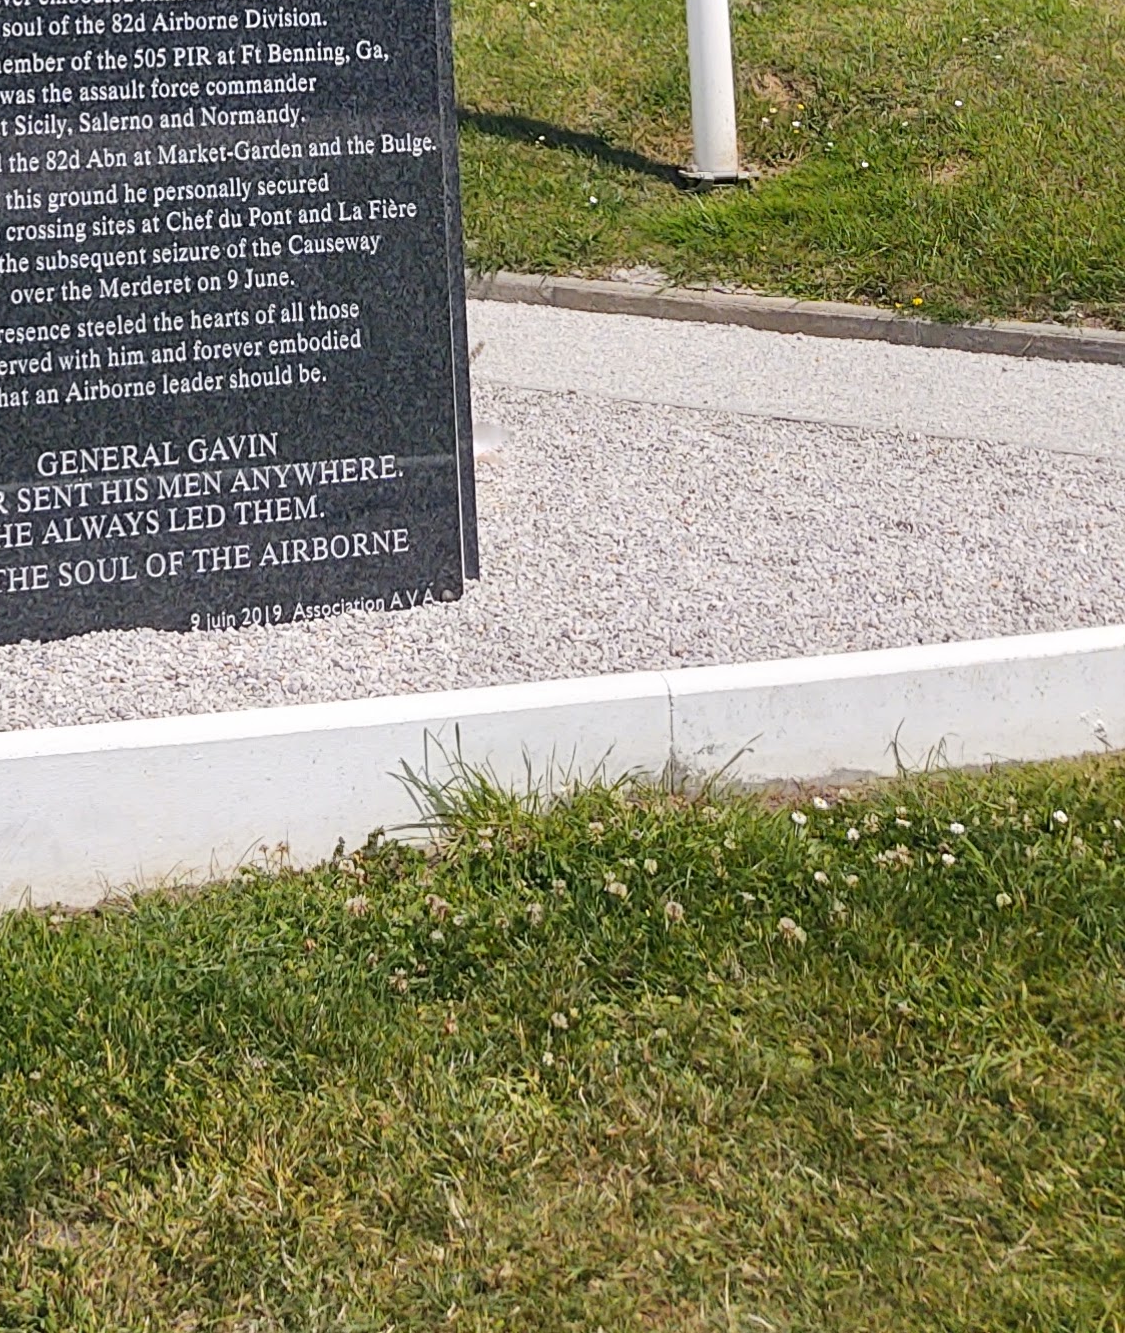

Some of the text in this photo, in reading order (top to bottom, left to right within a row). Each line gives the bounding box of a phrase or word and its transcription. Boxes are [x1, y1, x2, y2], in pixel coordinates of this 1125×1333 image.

[2, 16, 43, 38] soul
[48, 14, 71, 36] of
[74, 14, 106, 35] the
[111, 12, 147, 34] 82d
[151, 11, 239, 33] Airborne
[244, 6, 328, 29] Division.
[70, 50, 93, 72] of
[96, 48, 128, 71] the
[133, 47, 167, 69] 505
[172, 46, 212, 68] PIR
[216, 46, 236, 66] at
[240, 44, 262, 65] Ft
[267, 40, 351, 67] Benning,
[355, 38, 390, 63] Ga,
[41, 82, 73, 104] the
[79, 78, 146, 102] assault
[150, 76, 200, 99] force
[205, 72, 317, 97] commander
[14, 113, 73, 140] Sicily,
[79, 111, 154, 133] Salerno
[159, 107, 195, 129] and
[200, 102, 307, 129] Normandy.
[8, 151, 40, 173] the
[45, 148, 81, 171] 82d
[85, 147, 128, 169] Abn
[133, 148, 152, 167] at
[157, 138, 303, 165] Market-Garden
[308, 135, 342, 158] and
[346, 134, 375, 156] the
[380, 132, 437, 158] Bulge.
[5, 187, 42, 211] this
[47, 183, 119, 214] ground
[123, 182, 147, 204] he
[153, 176, 252, 208] personally
[257, 172, 330, 196] secured
[5, 217, 87, 243] crossing
[92, 215, 136, 237] sites
[141, 215, 160, 234] at
[166, 207, 214, 232] Chef
[218, 208, 243, 230] du
[247, 206, 293, 228] Pont
[298, 202, 333, 224] and
[337, 201, 364, 222] La
[367, 197, 418, 220] Fière
[35, 246, 147, 274] subsequent
[152, 241, 221, 264] seizure
[226, 237, 247, 259] of
[251, 236, 282, 258] the
[288, 234, 382, 256] Causeway
[10, 268, 296, 305] over the Merderet on 9 June.
[77, 312, 147, 338] steeled
[152, 311, 184, 332] the
[190, 308, 250, 330] hearts
[255, 303, 277, 325] of
[280, 301, 305, 324] all
[309, 299, 360, 321] those
[58, 347, 102, 371] with
[106, 345, 146, 368] him
[151, 340, 187, 364] and
[192, 339, 263, 361] forever
[268, 327, 362, 356] embodied
[35, 388, 60, 405] an
[64, 378, 156, 404] Airborne
[162, 371, 224, 395] leader
[229, 364, 293, 389] should
[298, 363, 327, 384] be.
[37, 431, 279, 477] GENERAL GAVIN
[17, 482, 93, 513] SENT
[99, 476, 149, 505] HIS
[156, 470, 223, 500] MEN
[230, 454, 404, 493] ANYWHERE.
[41, 509, 160, 545] ALWAYS
[167, 504, 226, 533] LED
[233, 493, 325, 526] THEM.
[58, 555, 138, 587] SOUL
[145, 550, 185, 578] OF
[191, 544, 252, 573] THE
[258, 528, 410, 567] AIRBORNE
[191, 596, 385, 631] 9 juin 2019 Association
